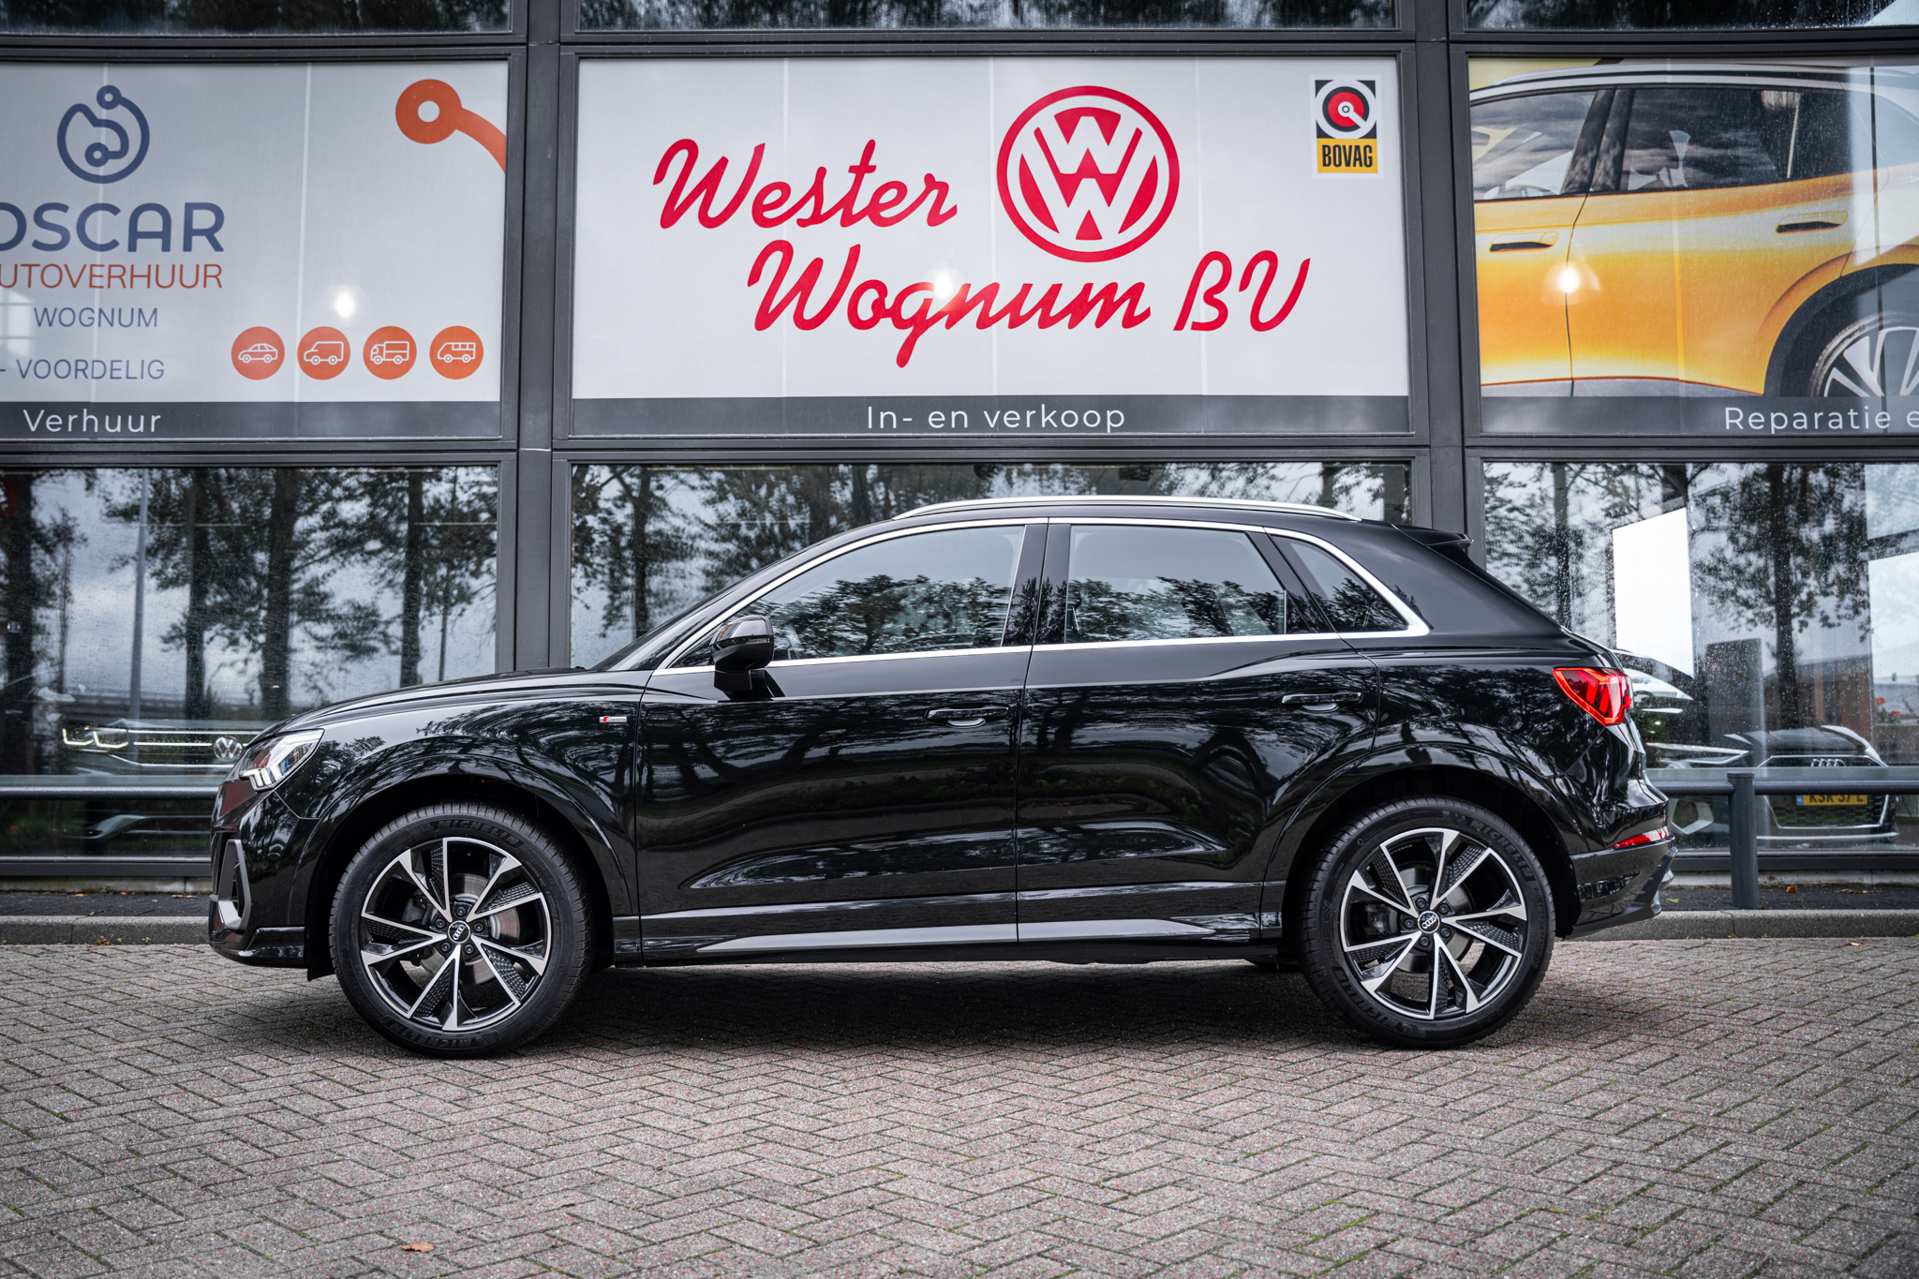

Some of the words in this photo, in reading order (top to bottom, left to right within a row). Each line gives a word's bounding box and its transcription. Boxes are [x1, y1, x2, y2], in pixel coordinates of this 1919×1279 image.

[1321, 144, 1373, 168] BOVAG
[653, 138, 957, 230] Wester
[33, 307, 158, 328] WOGNUM
[747, 240, 1152, 368] Wognum
[1173, 250, 1310, 332] BV
[16, 359, 165, 380] VOORDELIG
[23, 408, 161, 433] Verhuur
[867, 405, 912, 429] In-
[927, 411, 969, 429] en
[983, 404, 1126, 434] verkoop
[1724, 405, 1892, 434] Reparatie
[438, 819, 521, 847] MICHELIN
[1470, 819, 1534, 879] MICHELIN
